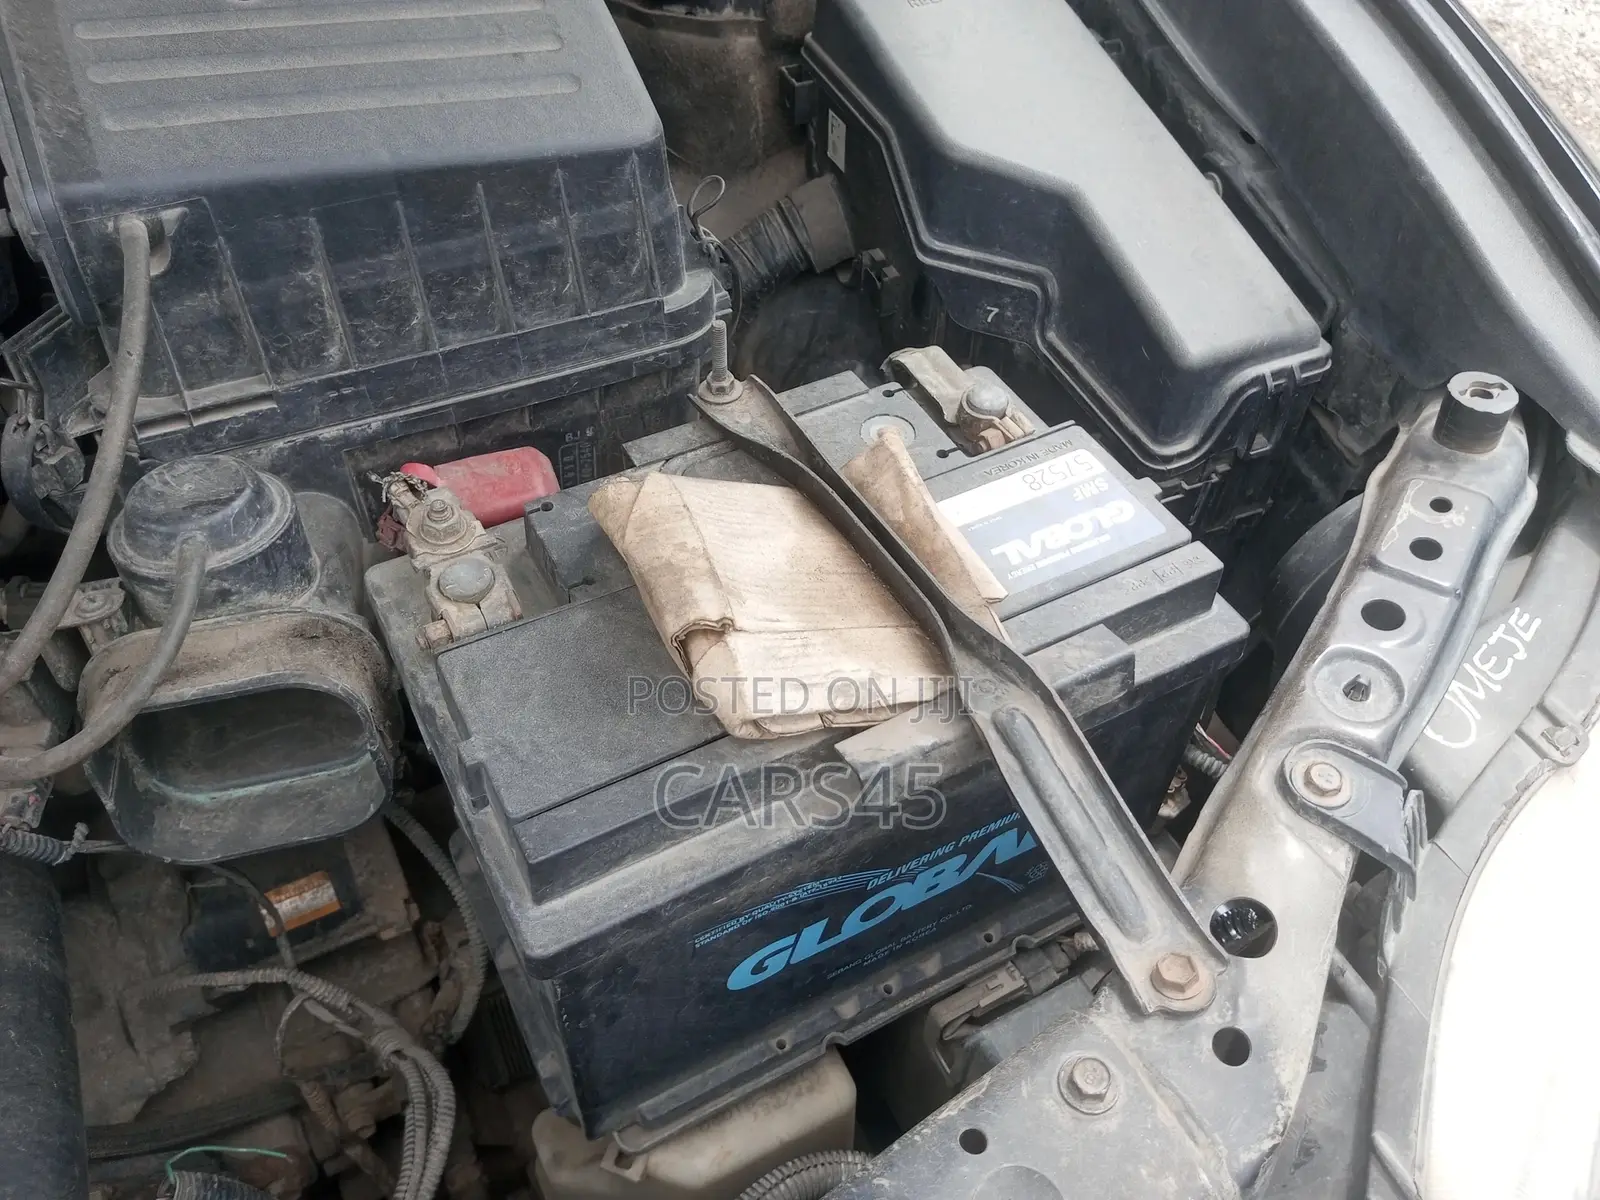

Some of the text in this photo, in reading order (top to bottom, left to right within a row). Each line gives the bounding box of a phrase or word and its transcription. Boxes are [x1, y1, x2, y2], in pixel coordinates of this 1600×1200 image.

[986, 306, 1000, 323] 7
[983, 439, 1073, 476] MADE IN KOREA
[1072, 477, 1109, 502] SMF
[990, 500, 1136, 566] GLOBAL
[866, 841, 956, 891] DELIVERING
[694, 923, 741, 949] STANDARD
[863, 941, 899, 959] GLOBAL
